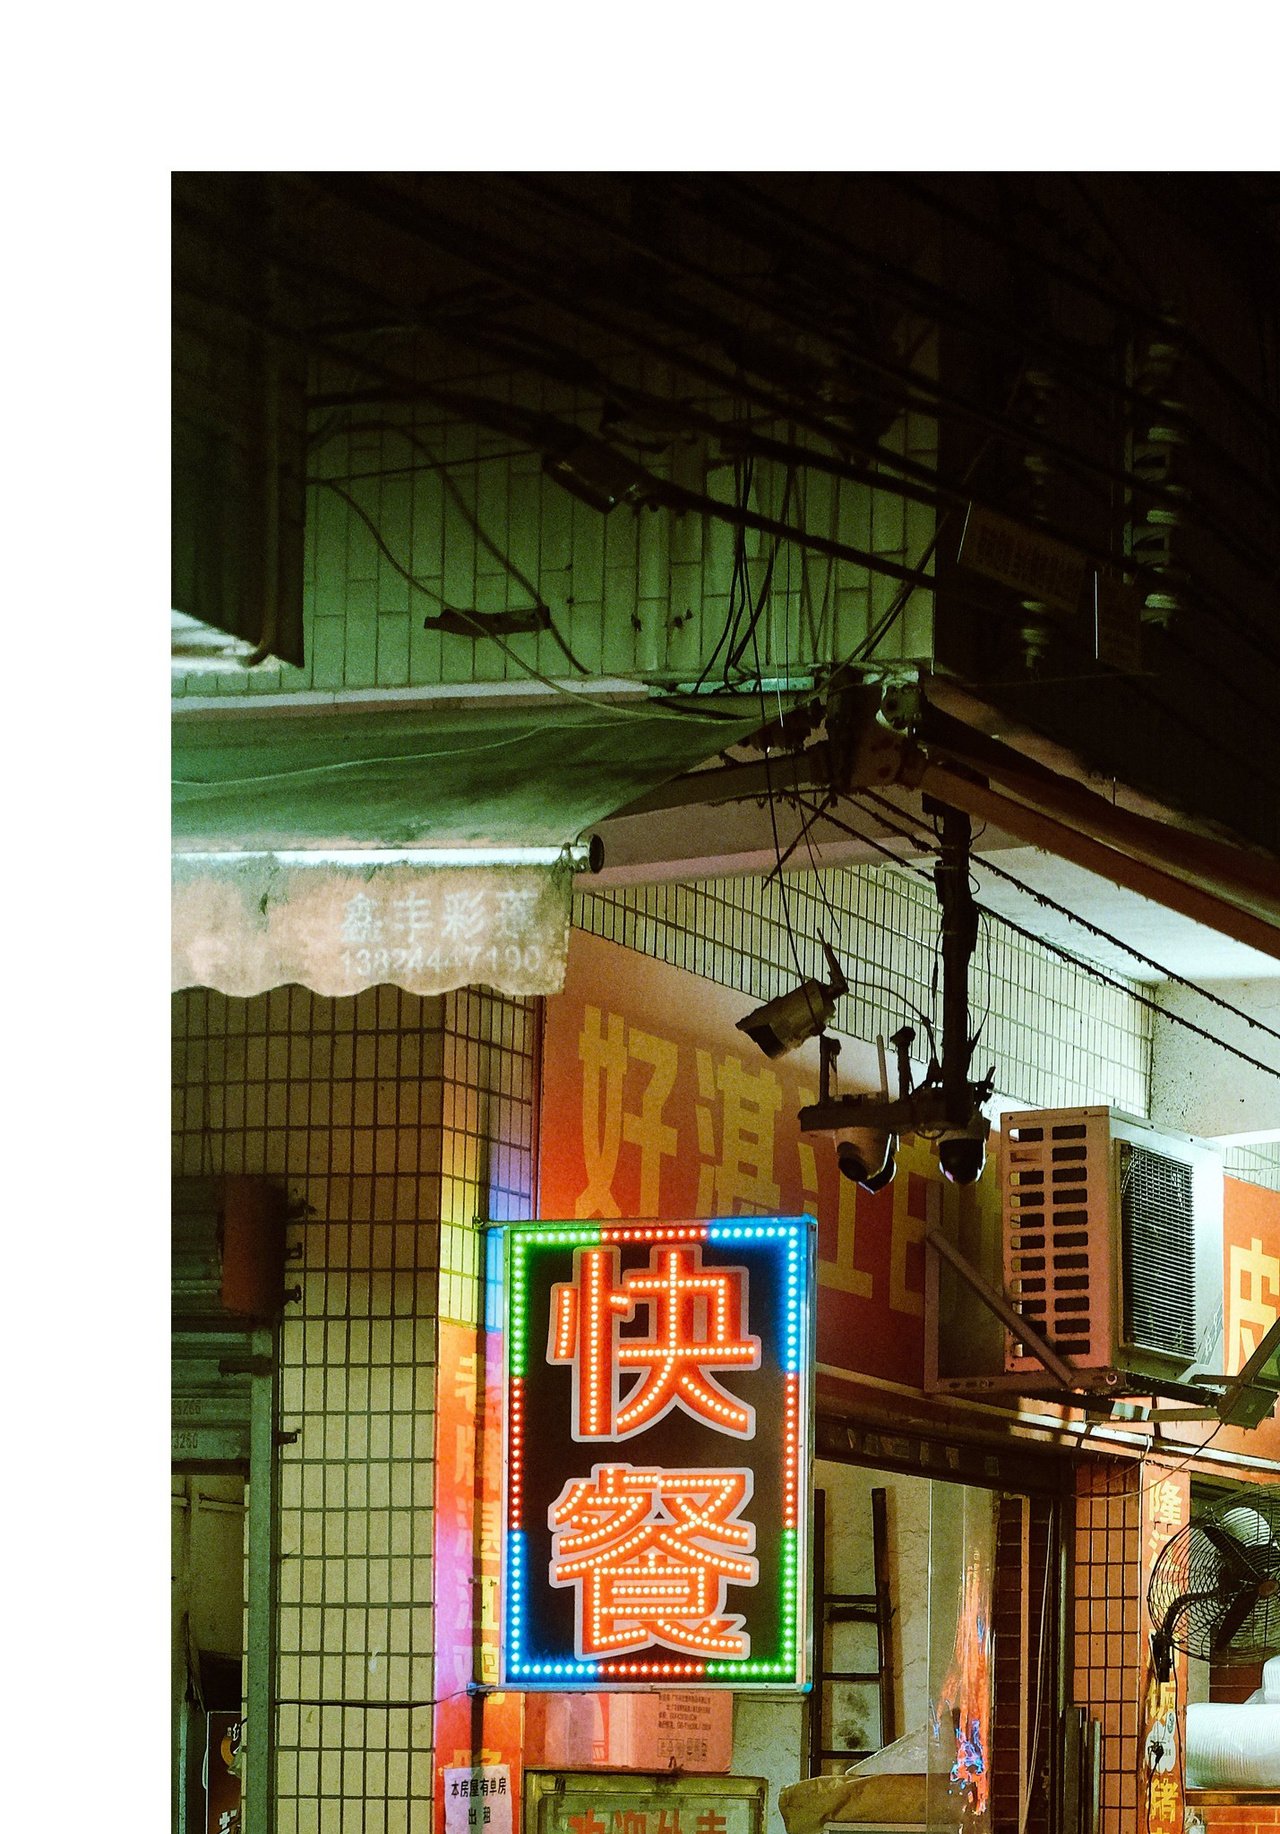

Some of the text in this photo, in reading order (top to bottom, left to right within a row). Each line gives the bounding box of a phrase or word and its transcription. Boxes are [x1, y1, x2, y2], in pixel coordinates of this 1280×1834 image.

[546, 1243, 762, 1661] 快餐
[450, 1776, 507, 1799] 本房屋有单房
[468, 1806, 491, 1826] 出租
